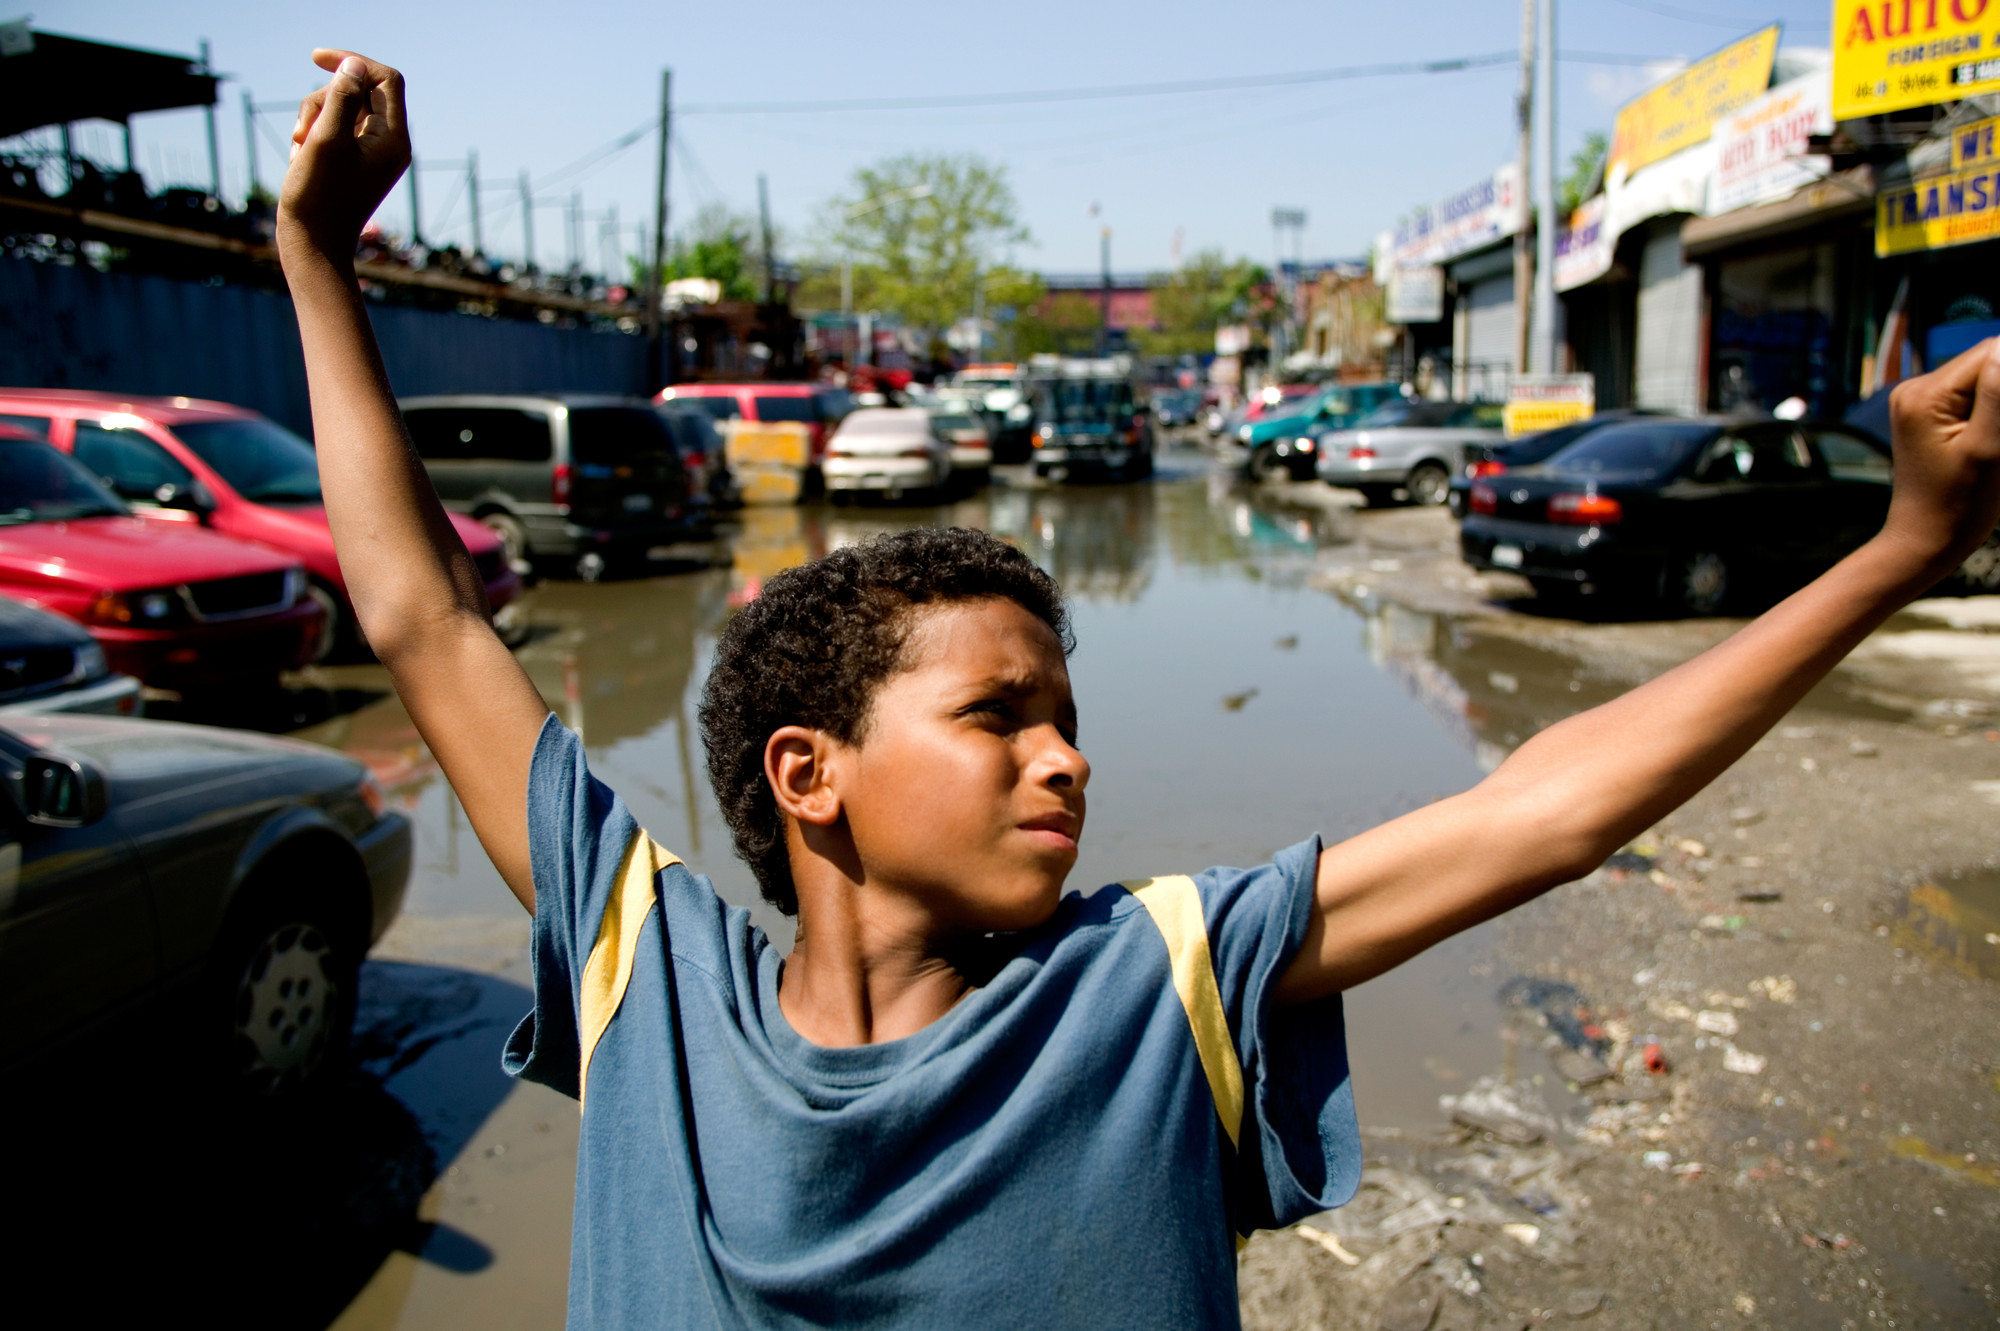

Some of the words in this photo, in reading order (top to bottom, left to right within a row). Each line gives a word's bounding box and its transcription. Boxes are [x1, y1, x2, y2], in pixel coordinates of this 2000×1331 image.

[1845, 0, 1988, 48] AUTO
[1887, 34, 1981, 67] FOREIGN
[1961, 126, 1993, 160] WE
[1886, 173, 2000, 228] TRANS
